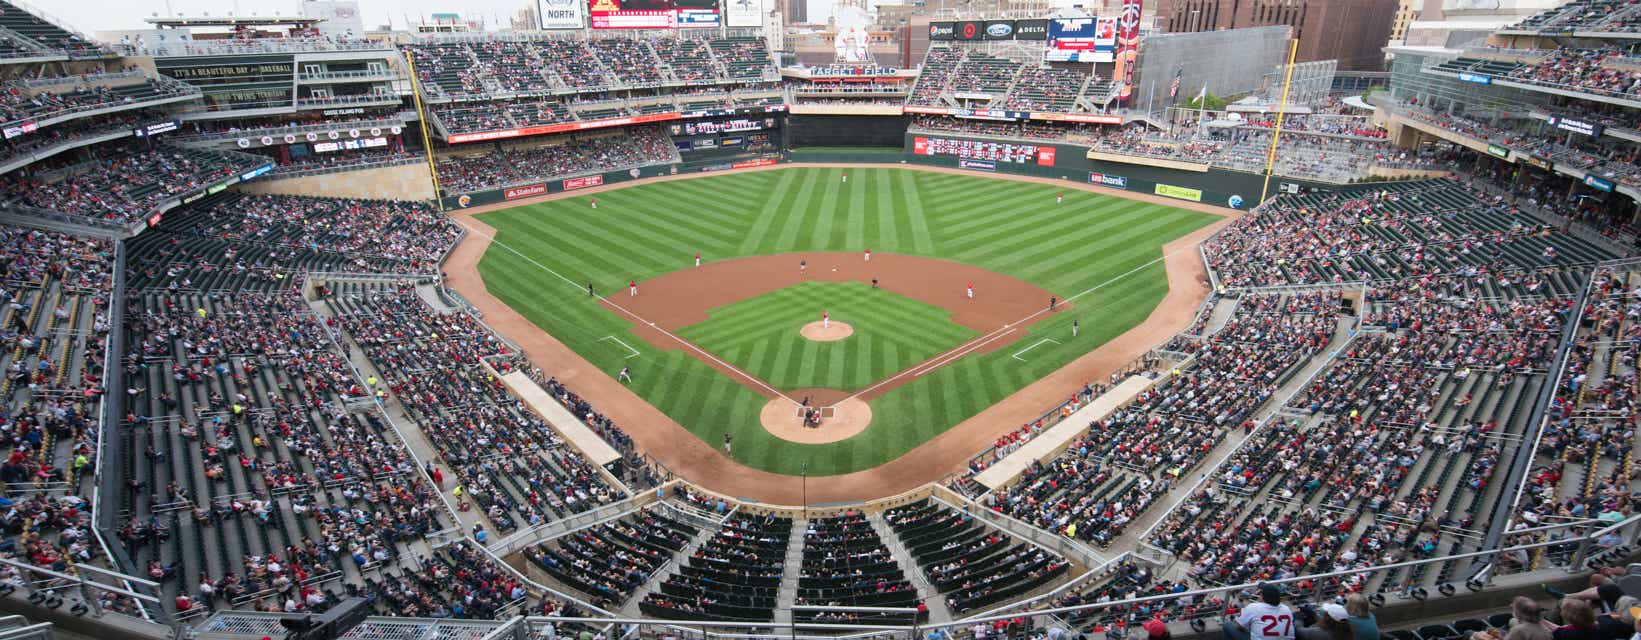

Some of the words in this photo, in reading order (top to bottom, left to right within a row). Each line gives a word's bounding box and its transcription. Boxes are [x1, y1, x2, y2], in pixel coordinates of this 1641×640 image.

[548, 10, 575, 19] NORTH
[192, 68, 197, 76] A
[198, 67, 235, 76] BEAUTIFUL
[236, 66, 249, 74] DAY
[811, 66, 854, 76] TARGET
[864, 67, 897, 76] FIELD
[1261, 614, 1292, 637] 27
